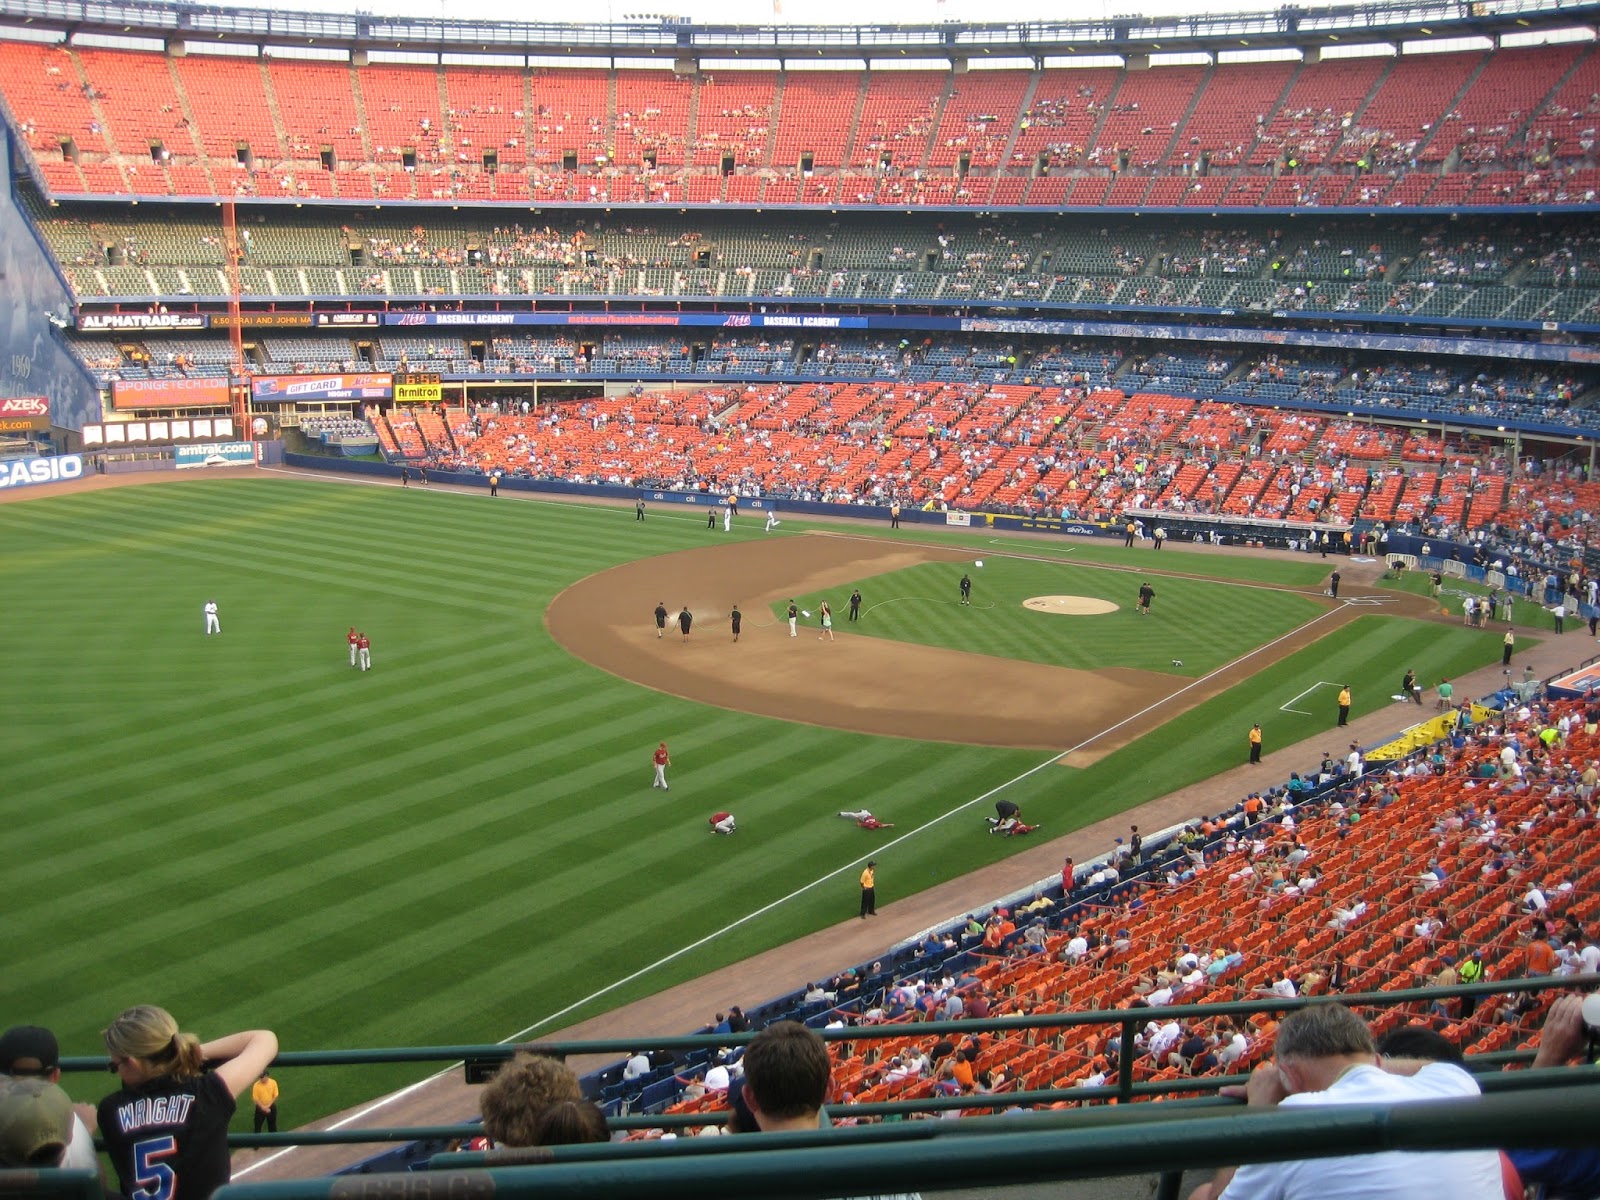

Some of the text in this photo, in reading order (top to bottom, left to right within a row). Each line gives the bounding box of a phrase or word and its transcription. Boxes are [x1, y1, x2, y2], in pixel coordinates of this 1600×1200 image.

[436, 314, 476, 324] BASEBALL
[476, 314, 515, 324] ACADEMY
[764, 316, 801, 325] BASEBALL
[803, 317, 840, 326] ACADEMY
[290, 380, 337, 393] GIFT CARD
[398, 387, 438, 397] Armitron
[2, 398, 42, 411] AZEK
[178, 443, 251, 456] amtrak.com
[119, 1094, 196, 1132] WRIGHT
[132, 1135, 178, 1200] 5
